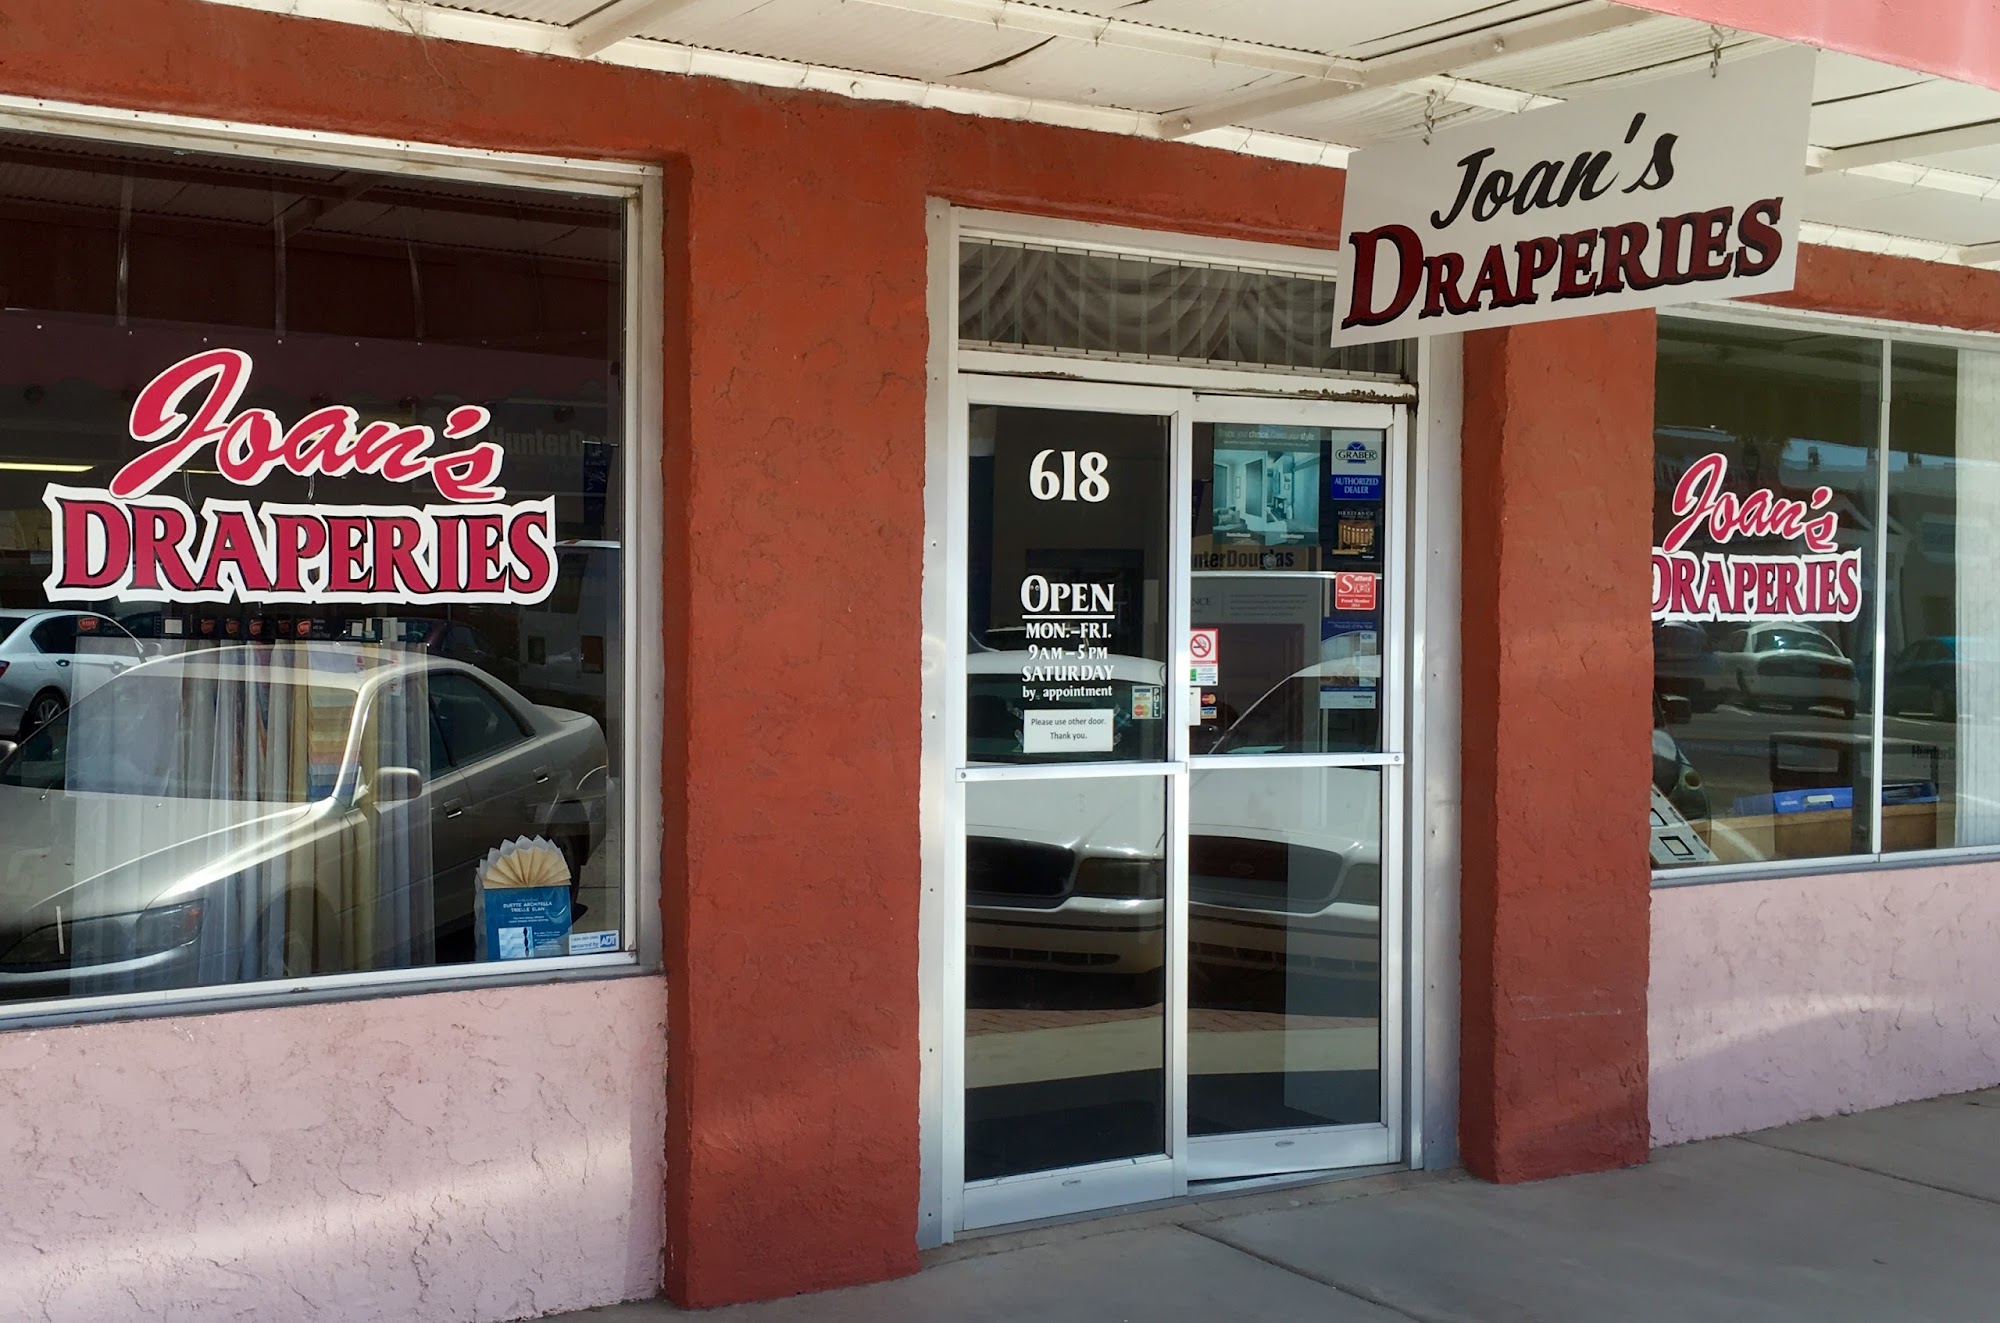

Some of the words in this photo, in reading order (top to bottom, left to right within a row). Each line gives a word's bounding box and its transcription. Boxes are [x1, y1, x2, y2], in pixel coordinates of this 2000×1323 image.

[1430, 111, 1679, 230] Joan's
[1340, 196, 1785, 331] DRAPERIES
[111, 348, 505, 502] Joan's
[1338, 451, 1376, 459] GRABER
[1030, 449, 1110, 502] 618
[1334, 477, 1379, 486] AUTHORIZED
[1344, 486, 1369, 494] DEALER
[1664, 452, 1839, 552] Joan's
[42, 482, 557, 605] DRAPERIES
[1020, 574, 1115, 613] OPEN
[1021, 665, 1115, 682] SATURDAY
[1022, 685, 1036, 701] by
[1042, 685, 1113, 701] appointment
[1031, 718, 1053, 726] Please
[1068, 717, 1087, 726] other
[1088, 717, 1107, 725] door.
[1050, 732, 1071, 740] Thank
[1072, 733, 1087, 741] you.
[600, 935, 616, 945] ADT
